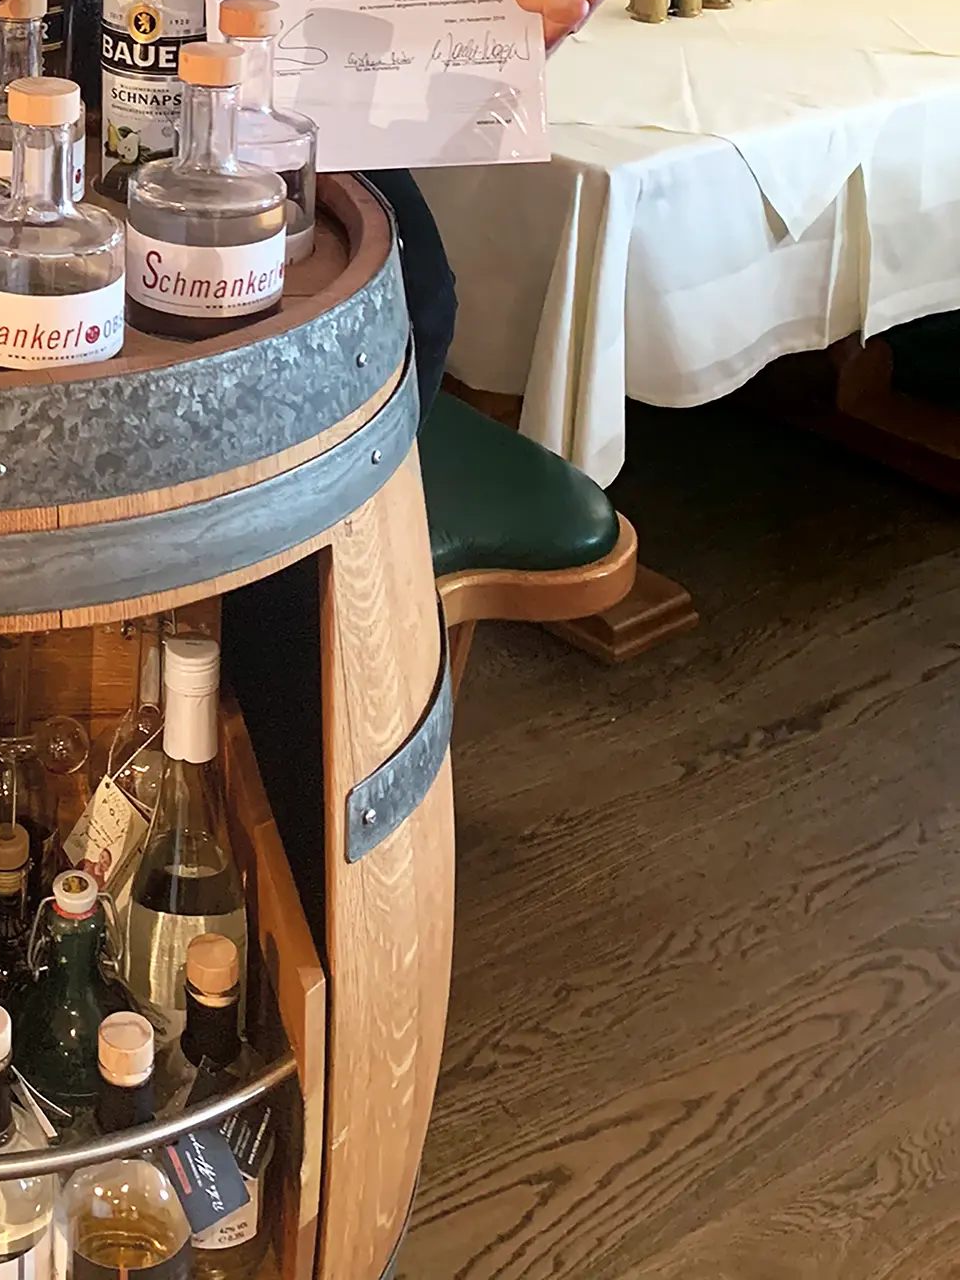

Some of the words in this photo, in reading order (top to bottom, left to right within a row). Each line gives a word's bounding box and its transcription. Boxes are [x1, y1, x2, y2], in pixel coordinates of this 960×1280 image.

[102, 33, 178, 68] BAUE
[111, 87, 182, 107] SCHNAPS
[142, 250, 281, 300] Schmankerl
